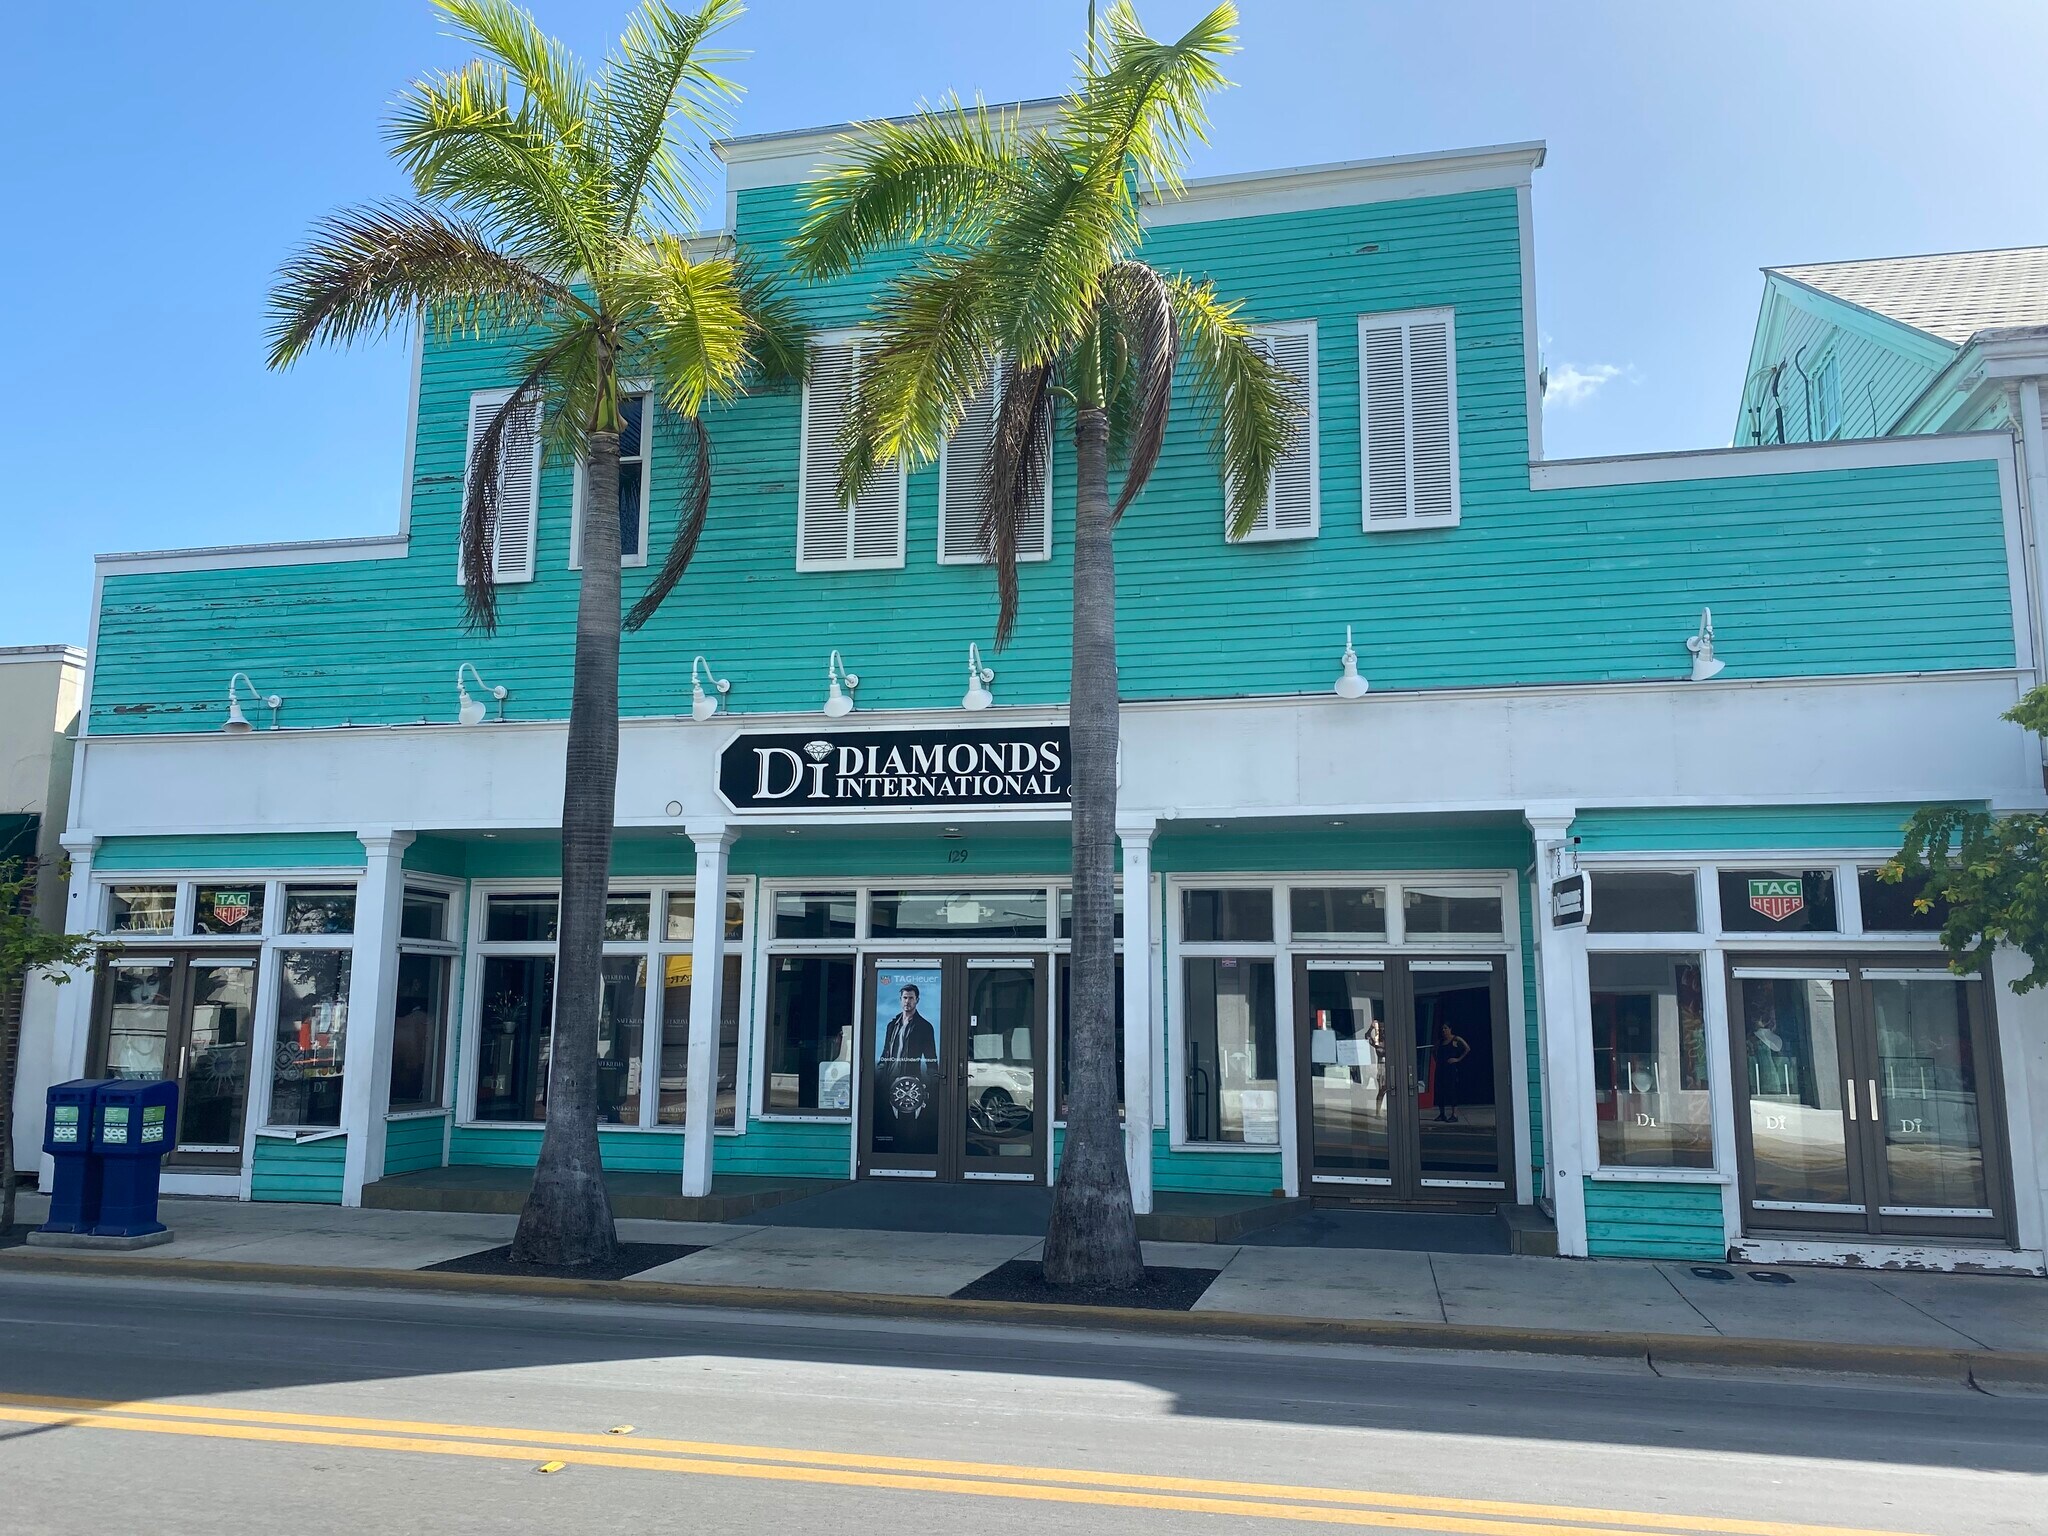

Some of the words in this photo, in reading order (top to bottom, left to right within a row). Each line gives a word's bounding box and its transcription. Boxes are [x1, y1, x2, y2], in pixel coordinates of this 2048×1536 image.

[836, 741, 1061, 777] DIAMONDS
[836, 774, 1061, 799] INTERNATIONAL
[947, 849, 968, 864] 129
[1753, 882, 1798, 895] TAG
[218, 894, 247, 905] TAG
[216, 906, 248, 922] HEUER
[1753, 898, 1800, 918] HEUER
[53, 1126, 77, 1138] see
[104, 1127, 127, 1140] see
[142, 1126, 163, 1139] see
